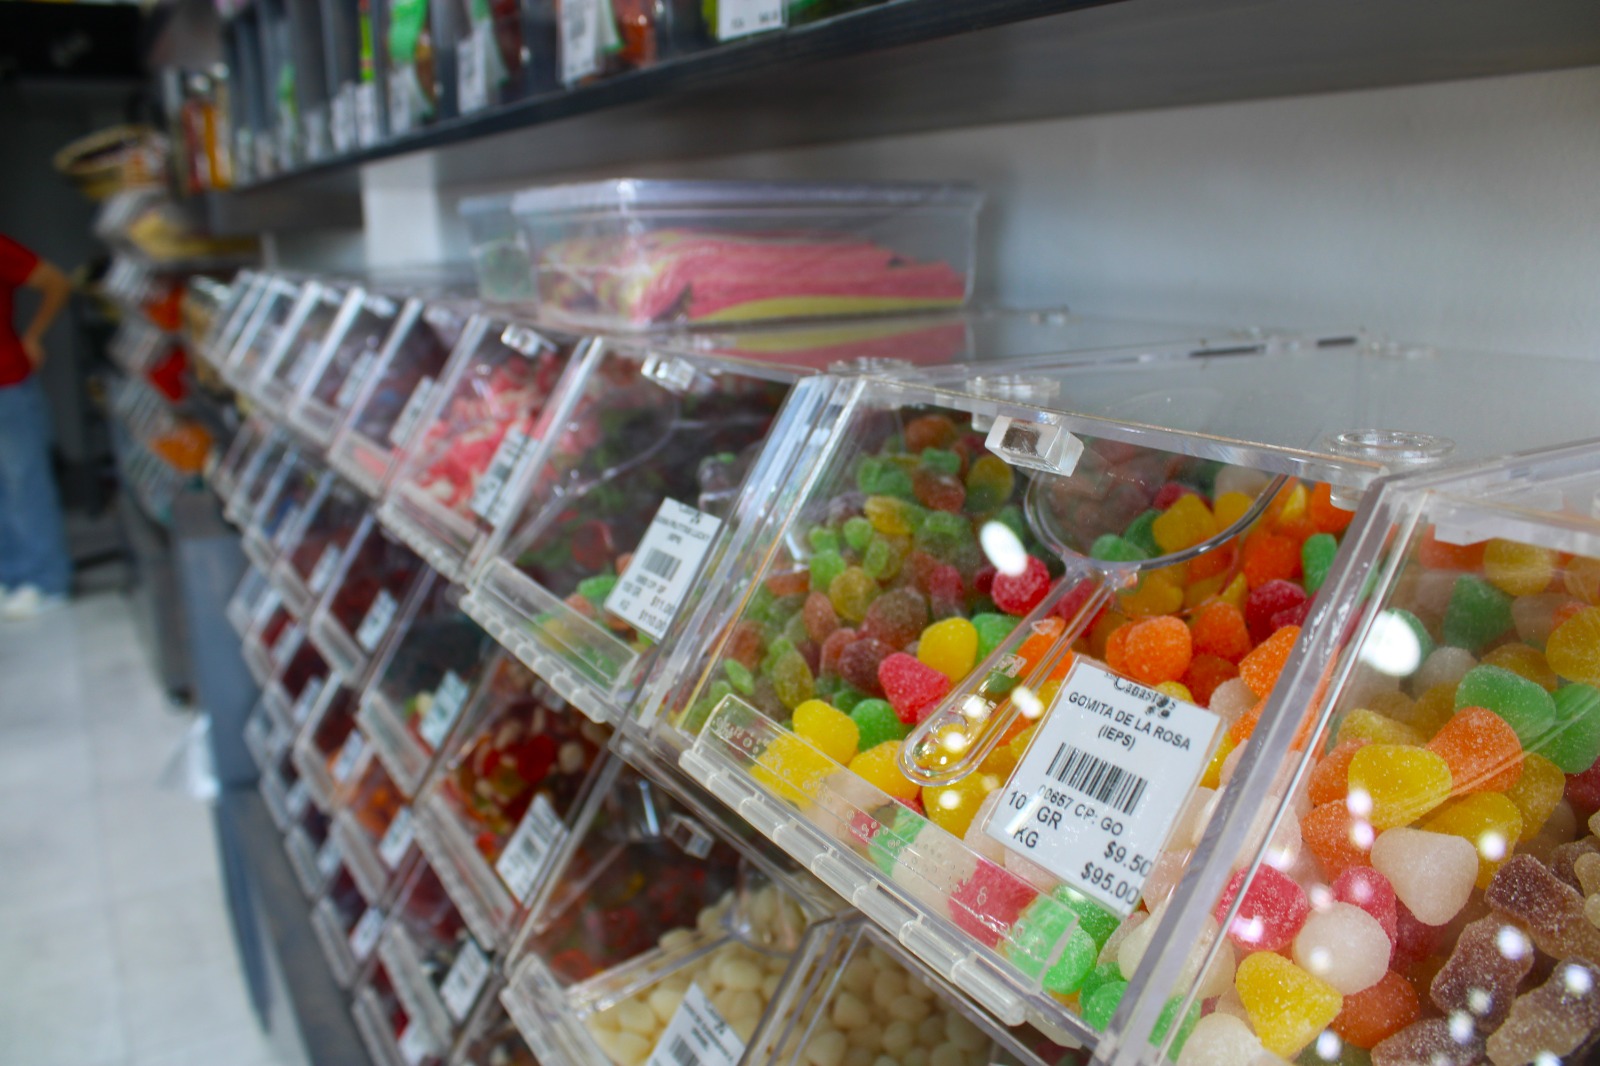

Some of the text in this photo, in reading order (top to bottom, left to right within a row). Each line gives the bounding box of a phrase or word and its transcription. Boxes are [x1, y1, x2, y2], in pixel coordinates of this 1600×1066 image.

[1068, 691, 1191, 751] GOMITA DE LA ROSA
[1097, 724, 1136, 751] (IEPS)
[1036, 805, 1062, 830] GR
[1074, 803, 1098, 825] CP:
[1100, 817, 1123, 836] GO
[1013, 826, 1039, 848] KG
[1103, 840, 1153, 878] $9.50
[1081, 861, 1140, 905] $95.00
